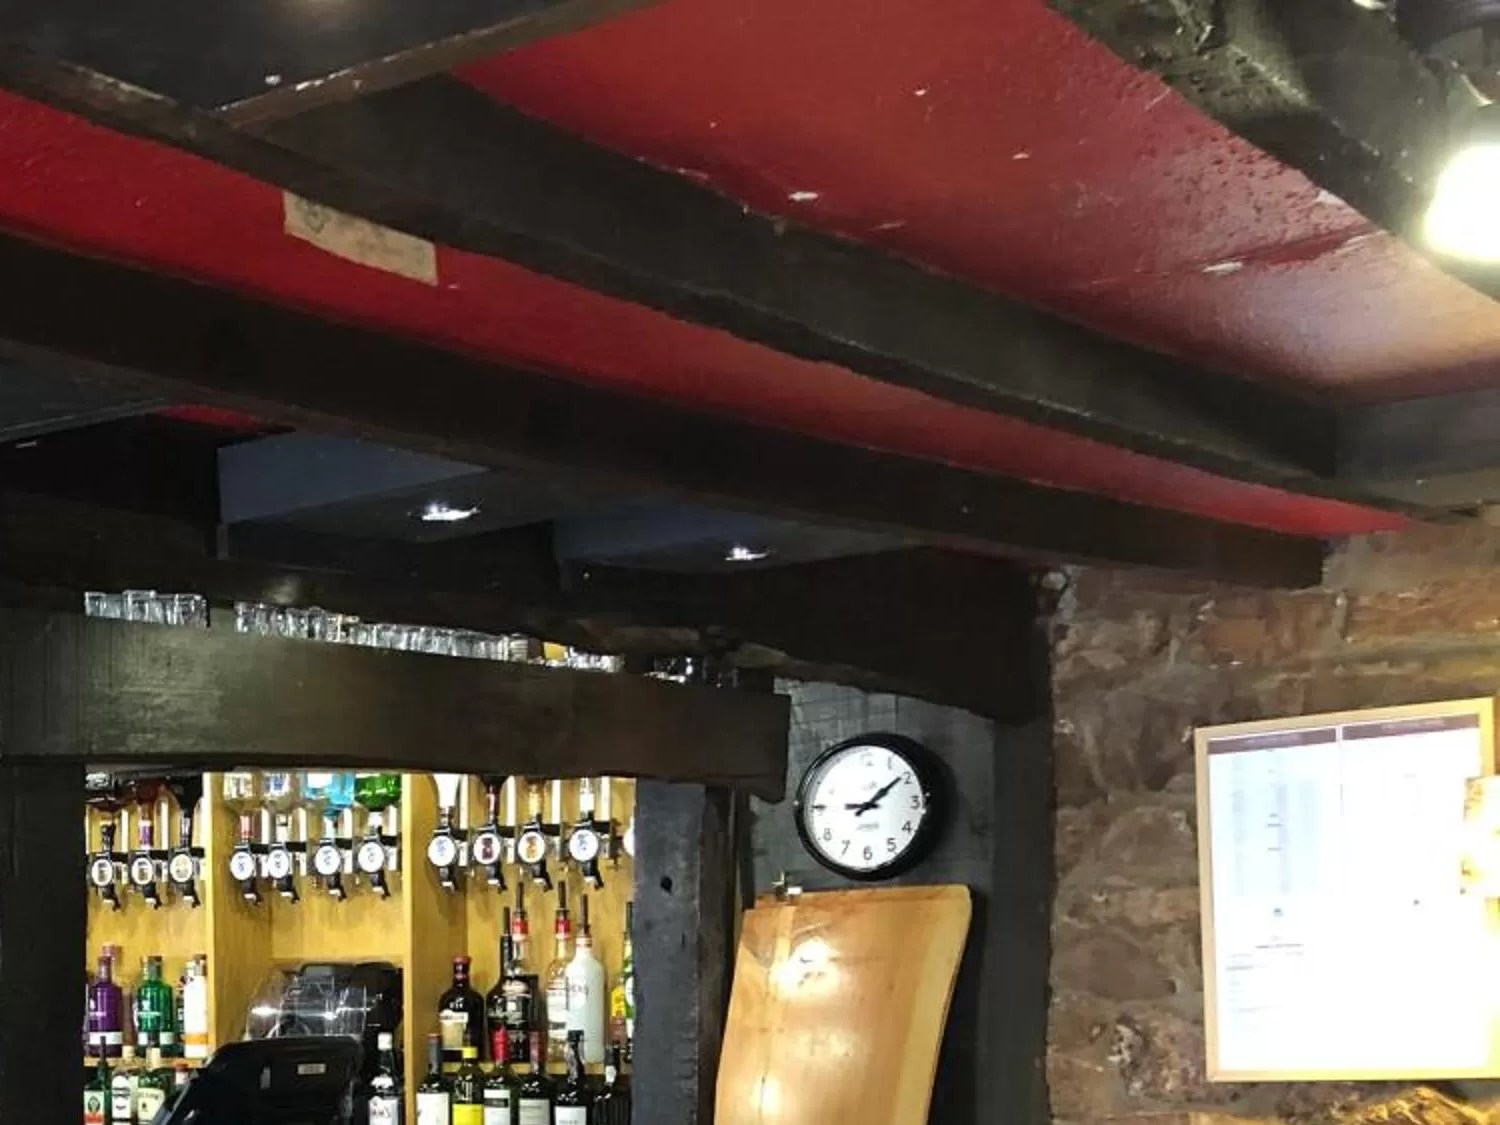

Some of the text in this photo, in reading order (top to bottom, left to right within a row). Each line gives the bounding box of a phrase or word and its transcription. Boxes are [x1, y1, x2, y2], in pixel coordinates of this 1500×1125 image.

[903, 771, 912, 784] 2
[911, 796, 921, 810] 3
[901, 821, 911, 834] 4
[823, 828, 832, 842] 8
[841, 840, 850, 855] 7
[887, 838, 897, 852] 5
[863, 846, 873, 860] 6
